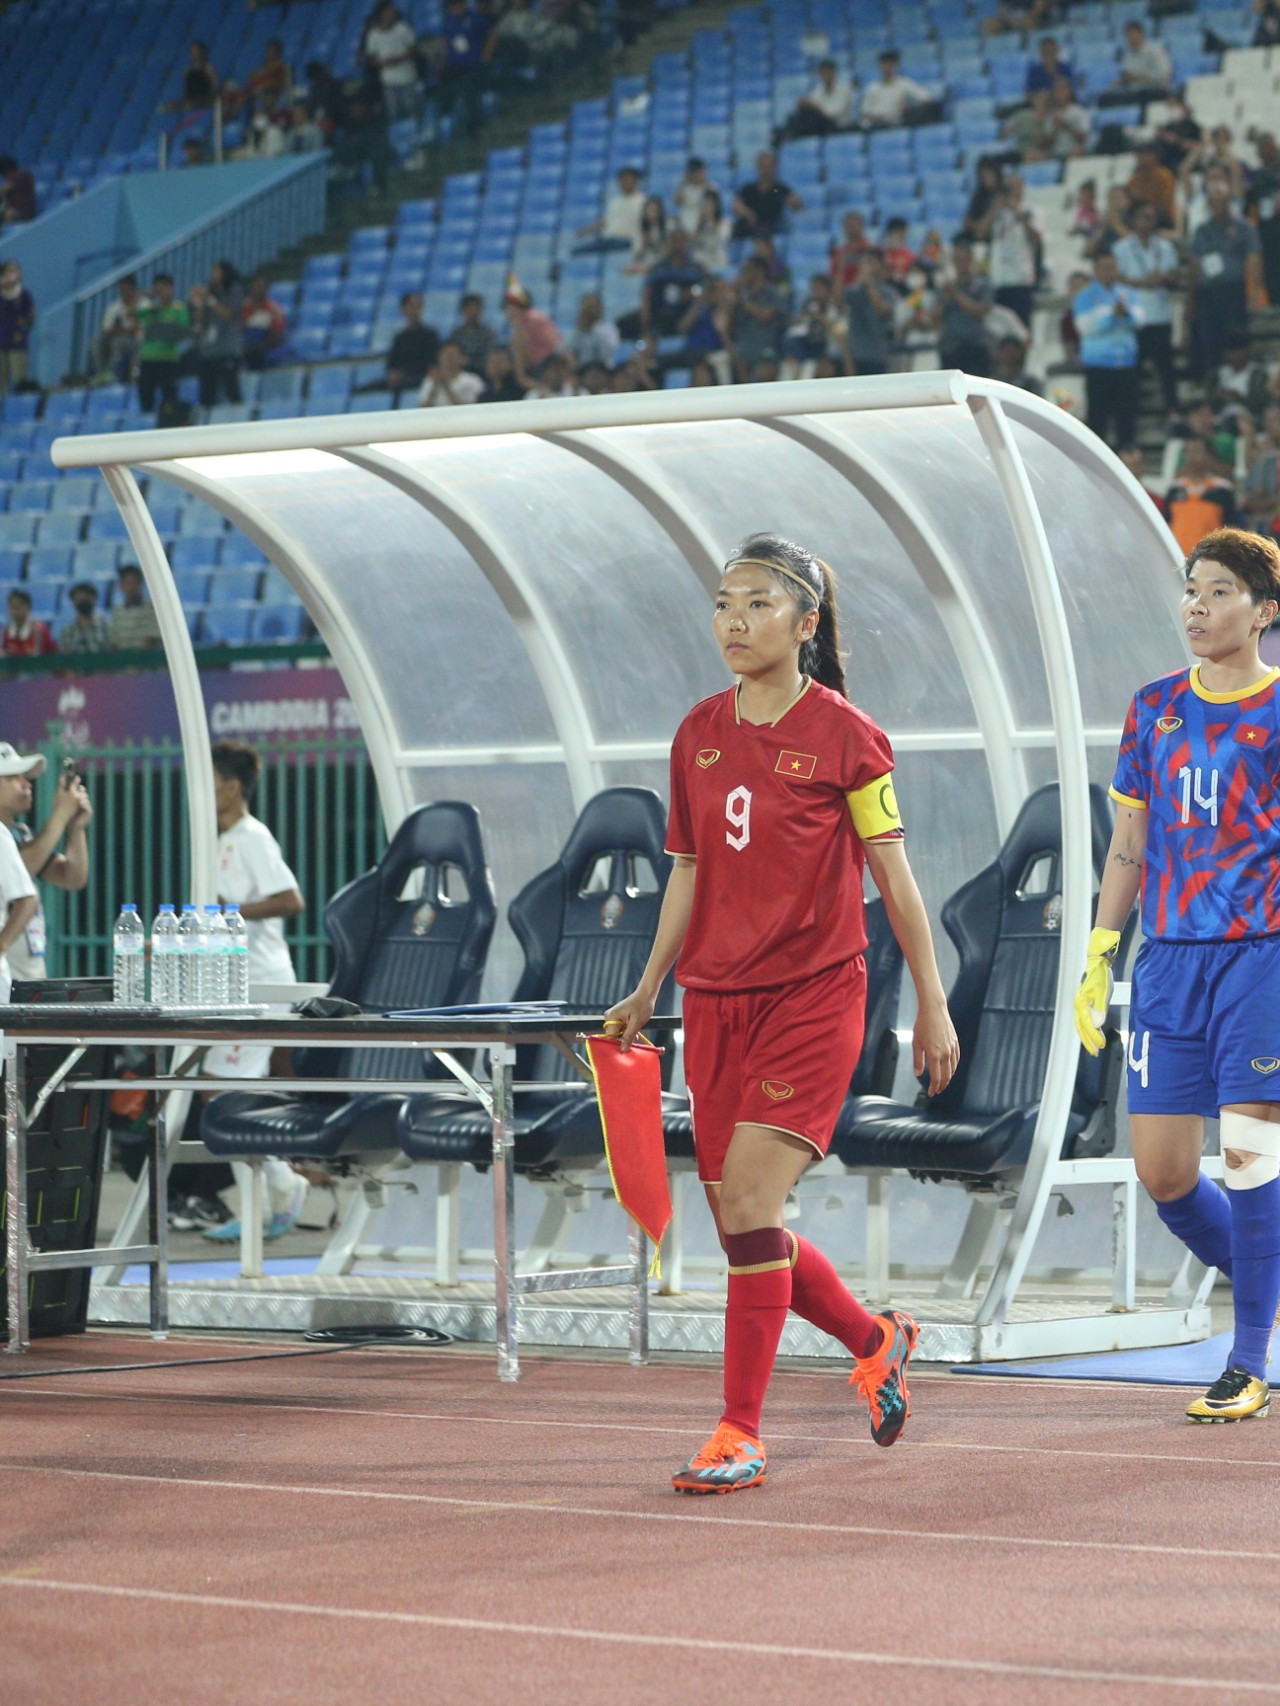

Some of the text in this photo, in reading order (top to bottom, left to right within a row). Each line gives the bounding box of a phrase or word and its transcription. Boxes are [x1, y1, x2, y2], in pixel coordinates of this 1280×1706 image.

[211, 698, 329, 735] CAMBODIA
[726, 785, 752, 851] 9
[1178, 766, 1218, 826] 14
[1125, 1030, 1150, 1089] 4
